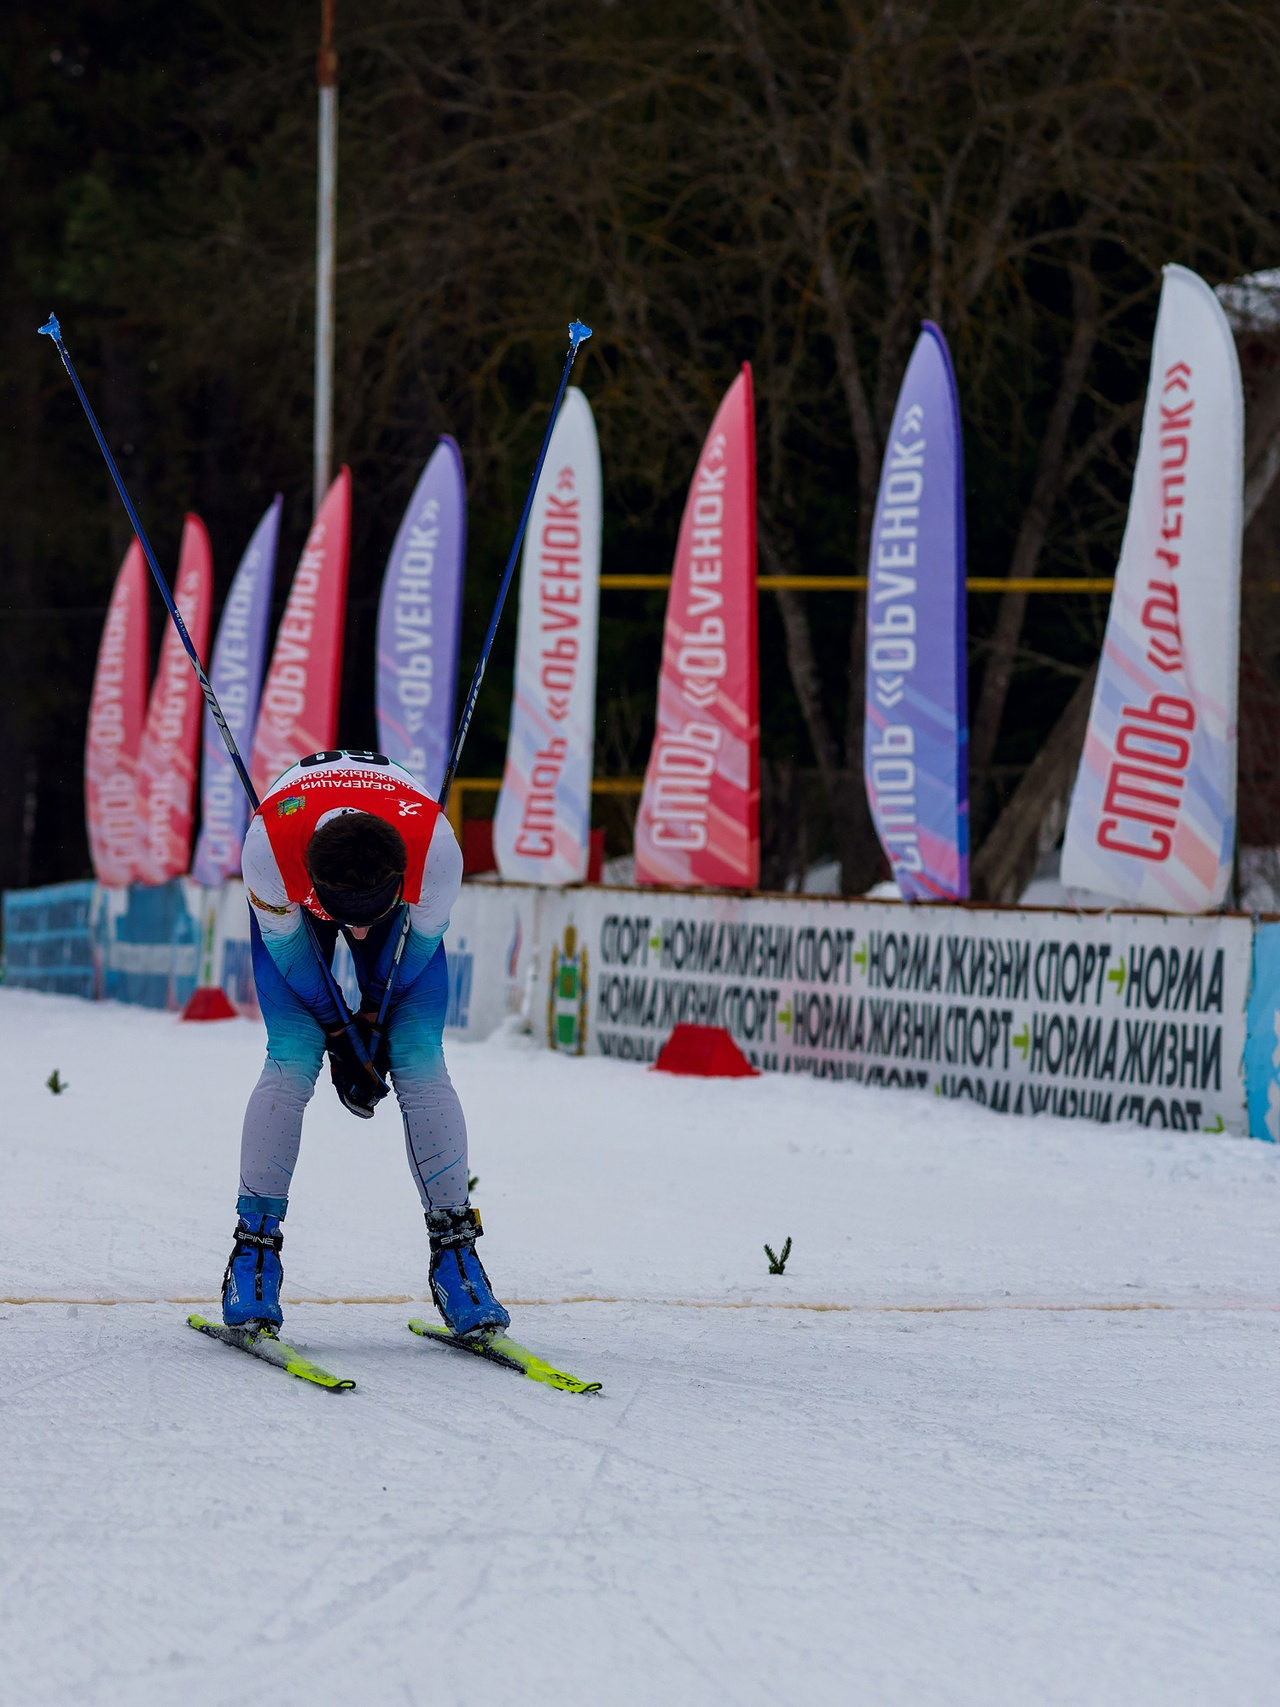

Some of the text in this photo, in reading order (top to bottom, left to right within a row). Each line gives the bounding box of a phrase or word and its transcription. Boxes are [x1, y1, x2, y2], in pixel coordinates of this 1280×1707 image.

[300, 779, 396, 791] ФЕДЕРАЦИЯ
[600, 914, 651, 968] СПОРТ
[795, 926, 854, 986] СПОРТ
[868, 930, 943, 993] НОРМА
[945, 934, 1030, 1001] ЖИЗНИ
[1034, 940, 1111, 1006] СПОРТ
[1125, 944, 1224, 1014] НОРМА
[793, 990, 865, 1051] НОРМА
[866, 997, 942, 1063] ЖИЗНИ
[944, 1004, 1013, 1071] СПОРТ
[1030, 1012, 1120, 1082] НОРМА
[1120, 1017, 1222, 1092] ЖИЗНИ
[238, 1231, 274, 1246] SPINE
[440, 1229, 476, 1246] SPINE
